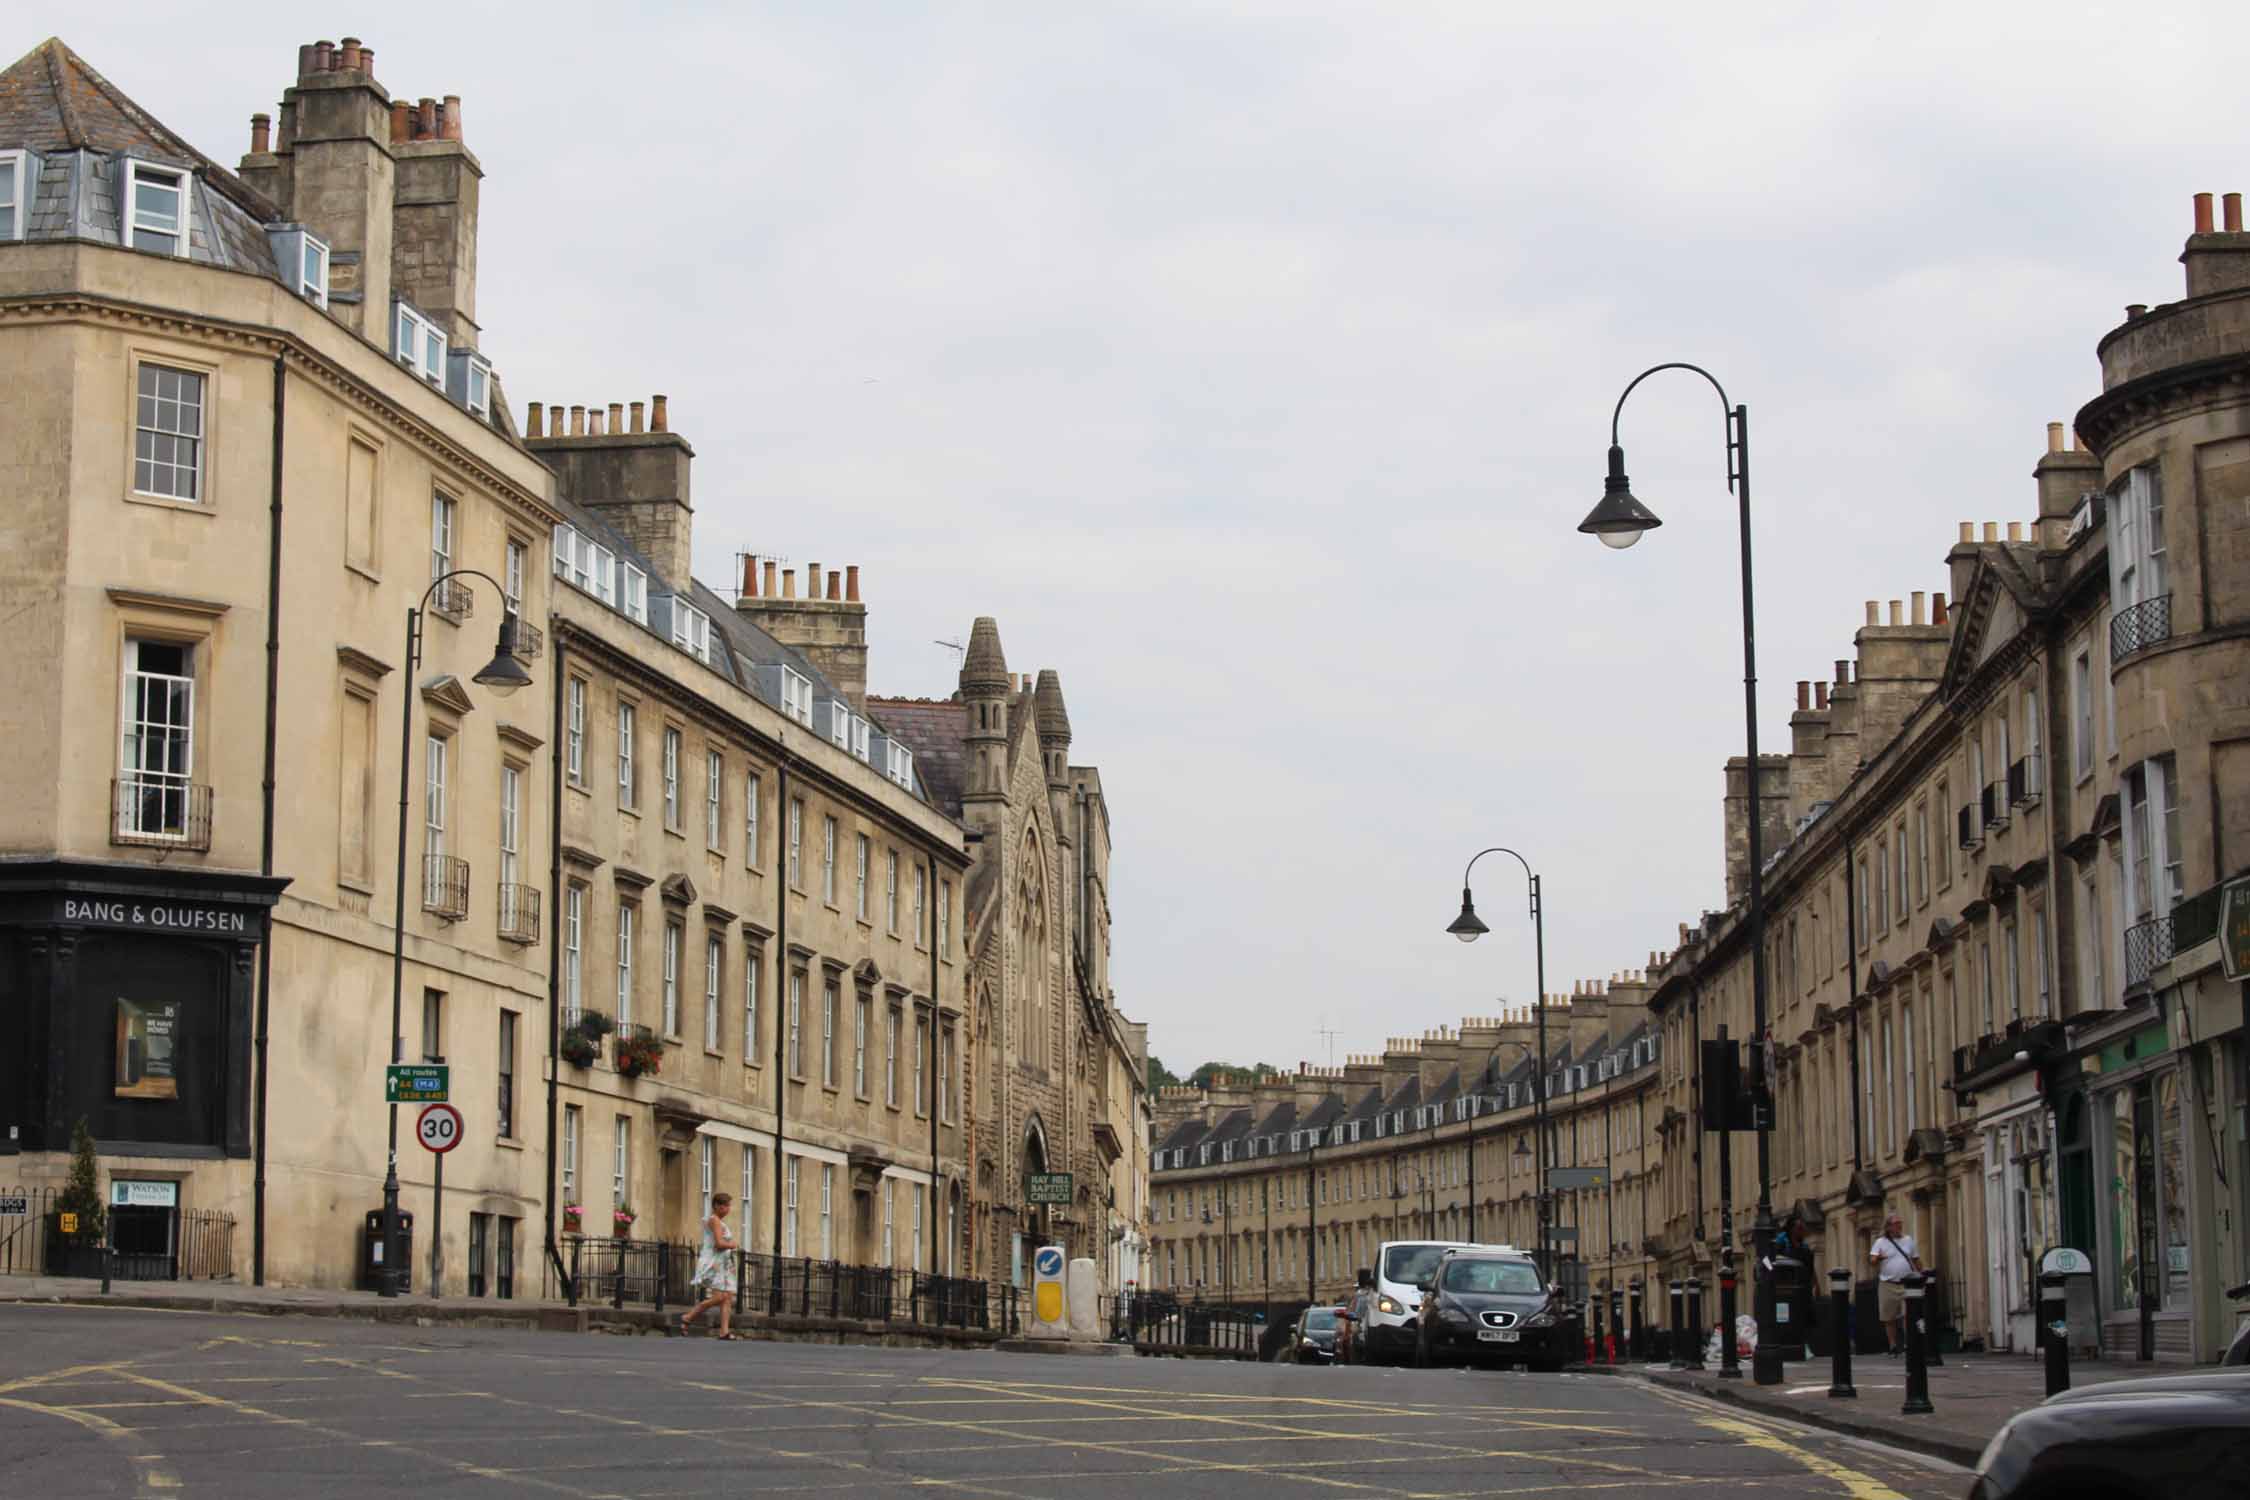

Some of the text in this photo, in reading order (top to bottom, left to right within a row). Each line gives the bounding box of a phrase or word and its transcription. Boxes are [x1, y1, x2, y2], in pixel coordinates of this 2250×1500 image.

[65, 900, 244, 931] BANG & OLUFSEN
[400, 1068, 438, 1077] All routes
[415, 1080, 438, 1089] (M4)
[423, 1119, 454, 1138] 30
[1031, 1184, 1070, 1193] BAPTIST
[1031, 1193, 1070, 1201] CHURCH
